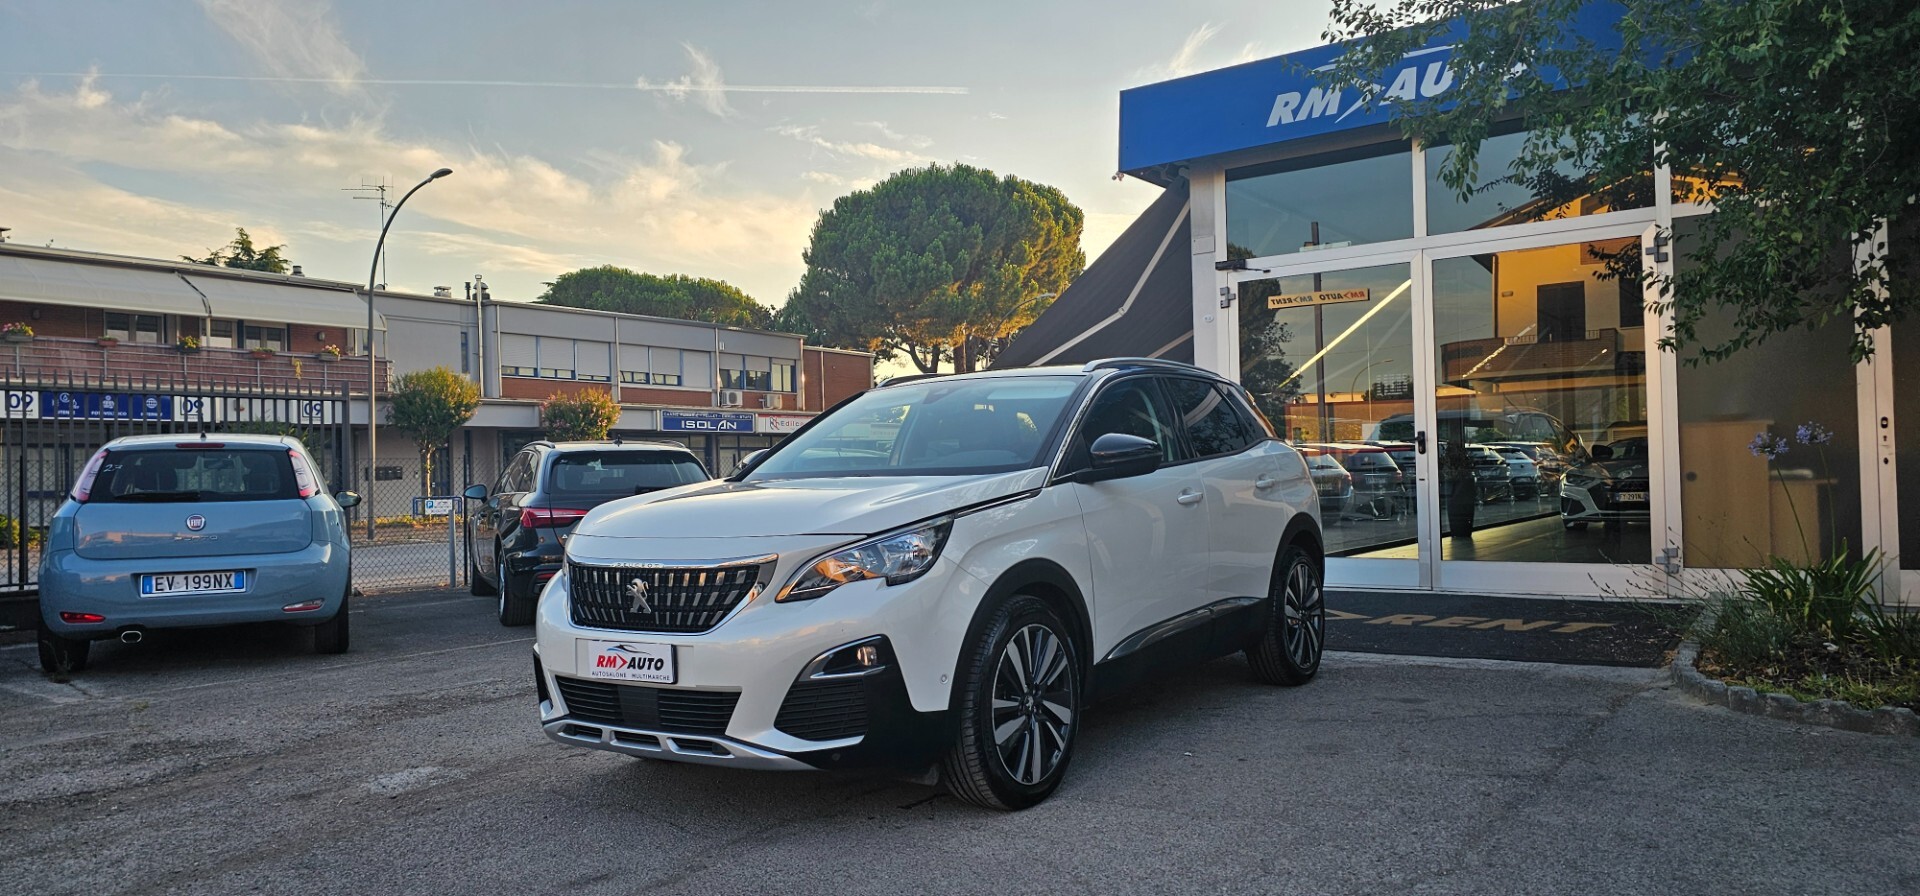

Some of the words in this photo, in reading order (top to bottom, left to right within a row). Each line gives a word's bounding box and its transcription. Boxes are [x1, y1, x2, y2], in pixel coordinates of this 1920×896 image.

[1266, 87, 1341, 128] RM
[7, 393, 34, 410] 09
[304, 403, 322, 415] 09
[681, 420, 737, 432] ISOLAN
[155, 576, 175, 591] EV
[184, 573, 233, 590] 199NX
[1363, 613, 1617, 634] RENT
[596, 654, 617, 668] RM
[627, 657, 664, 671] AUTO
[591, 670, 627, 678] AUTOSALONE
[631, 673, 670, 681] MULTIMARCHE
